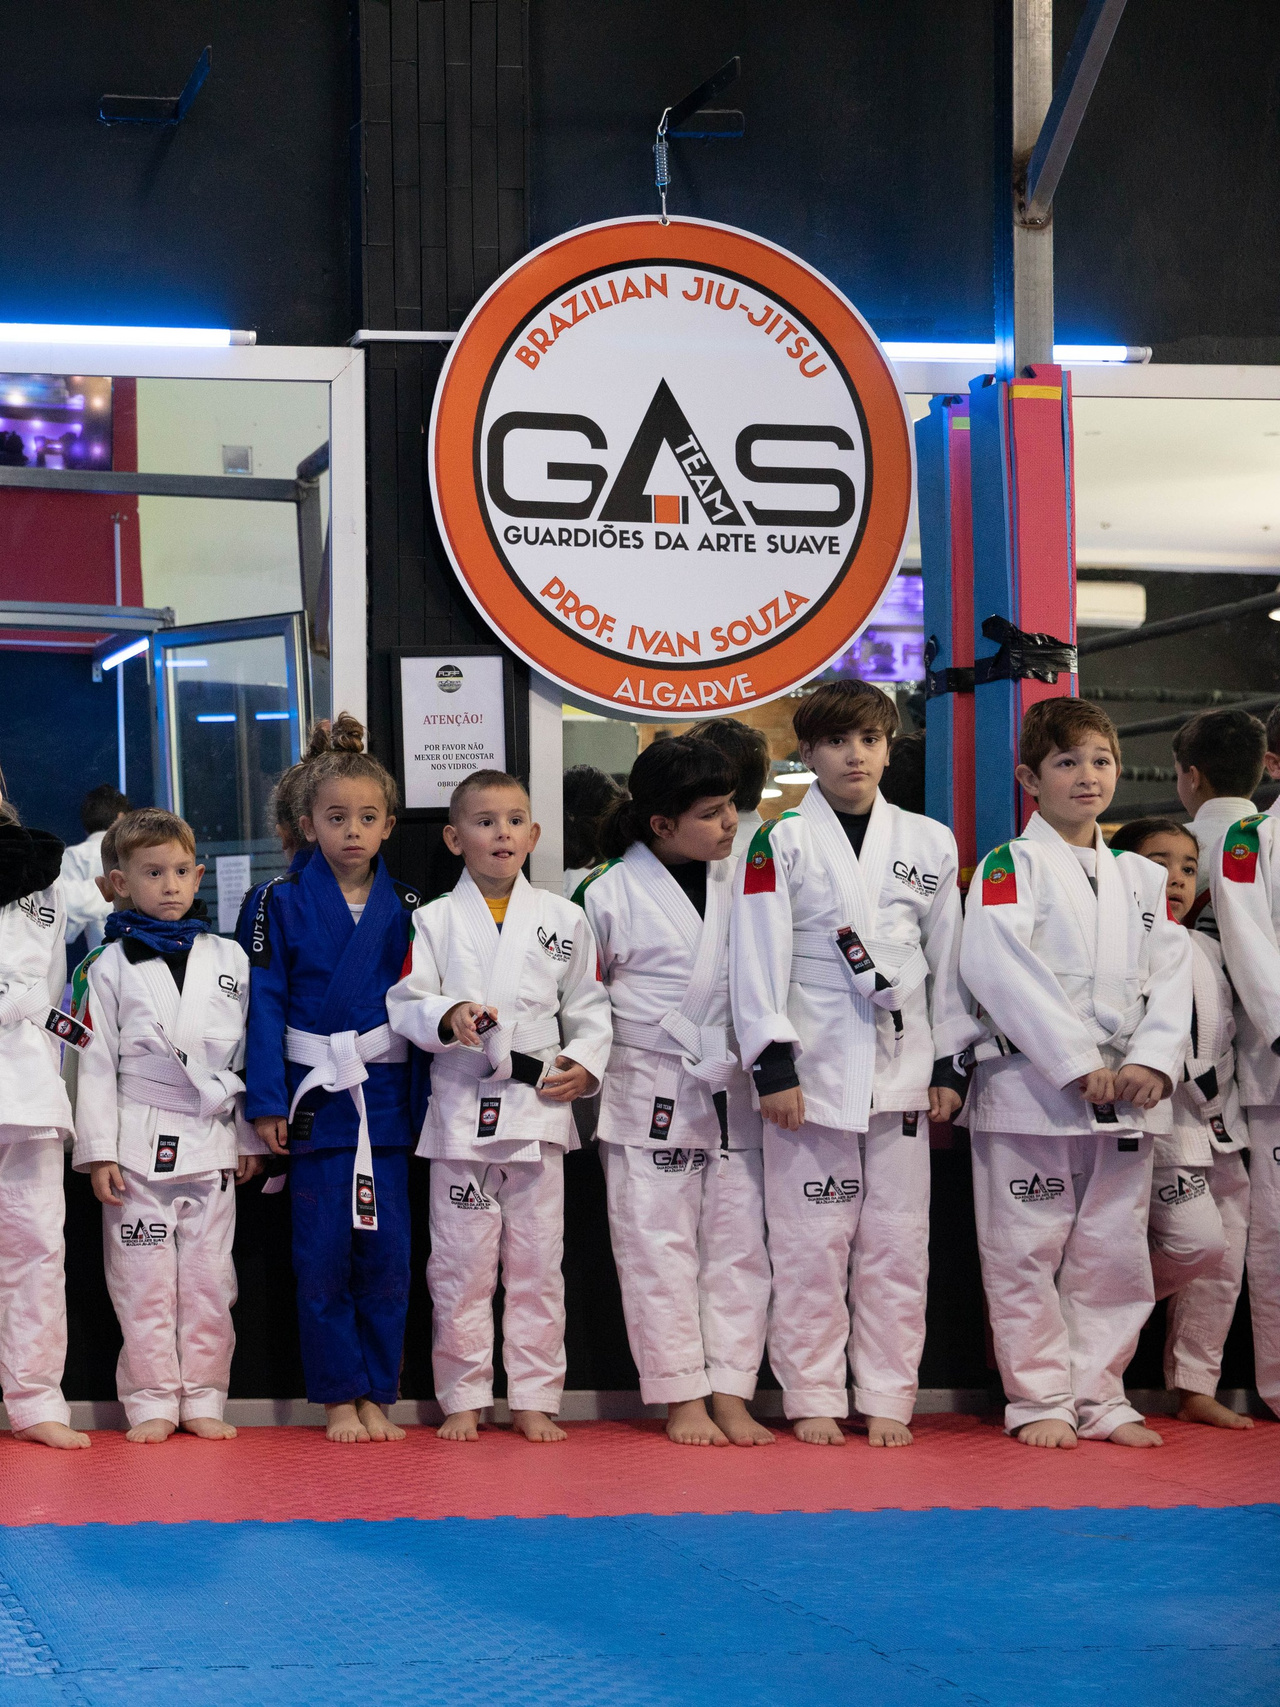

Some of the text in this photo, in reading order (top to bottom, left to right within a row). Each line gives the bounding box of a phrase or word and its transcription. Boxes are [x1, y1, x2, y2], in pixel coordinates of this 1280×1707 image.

[515, 273, 827, 379] BRAZILIAN JIU-JITSU
[487, 377, 856, 528] GAS
[674, 434, 733, 523] TEAM
[503, 524, 840, 555] GUARDIÕES DA ARTE SUAVE
[539, 576, 810, 658] PROF. IVAN SOUZA
[613, 673, 756, 708] ALGARVE
[423, 712, 483, 726] ATENÇÃO!
[468, 742, 484, 750] NÃO
[893, 860, 939, 891] GAS
[450, 1182, 489, 1202] GA
[803, 1175, 860, 1197] GAS
[1009, 1173, 1065, 1195] GAS
[1158, 1174, 1206, 1202] GAS
[121, 1217, 167, 1239] GAS
